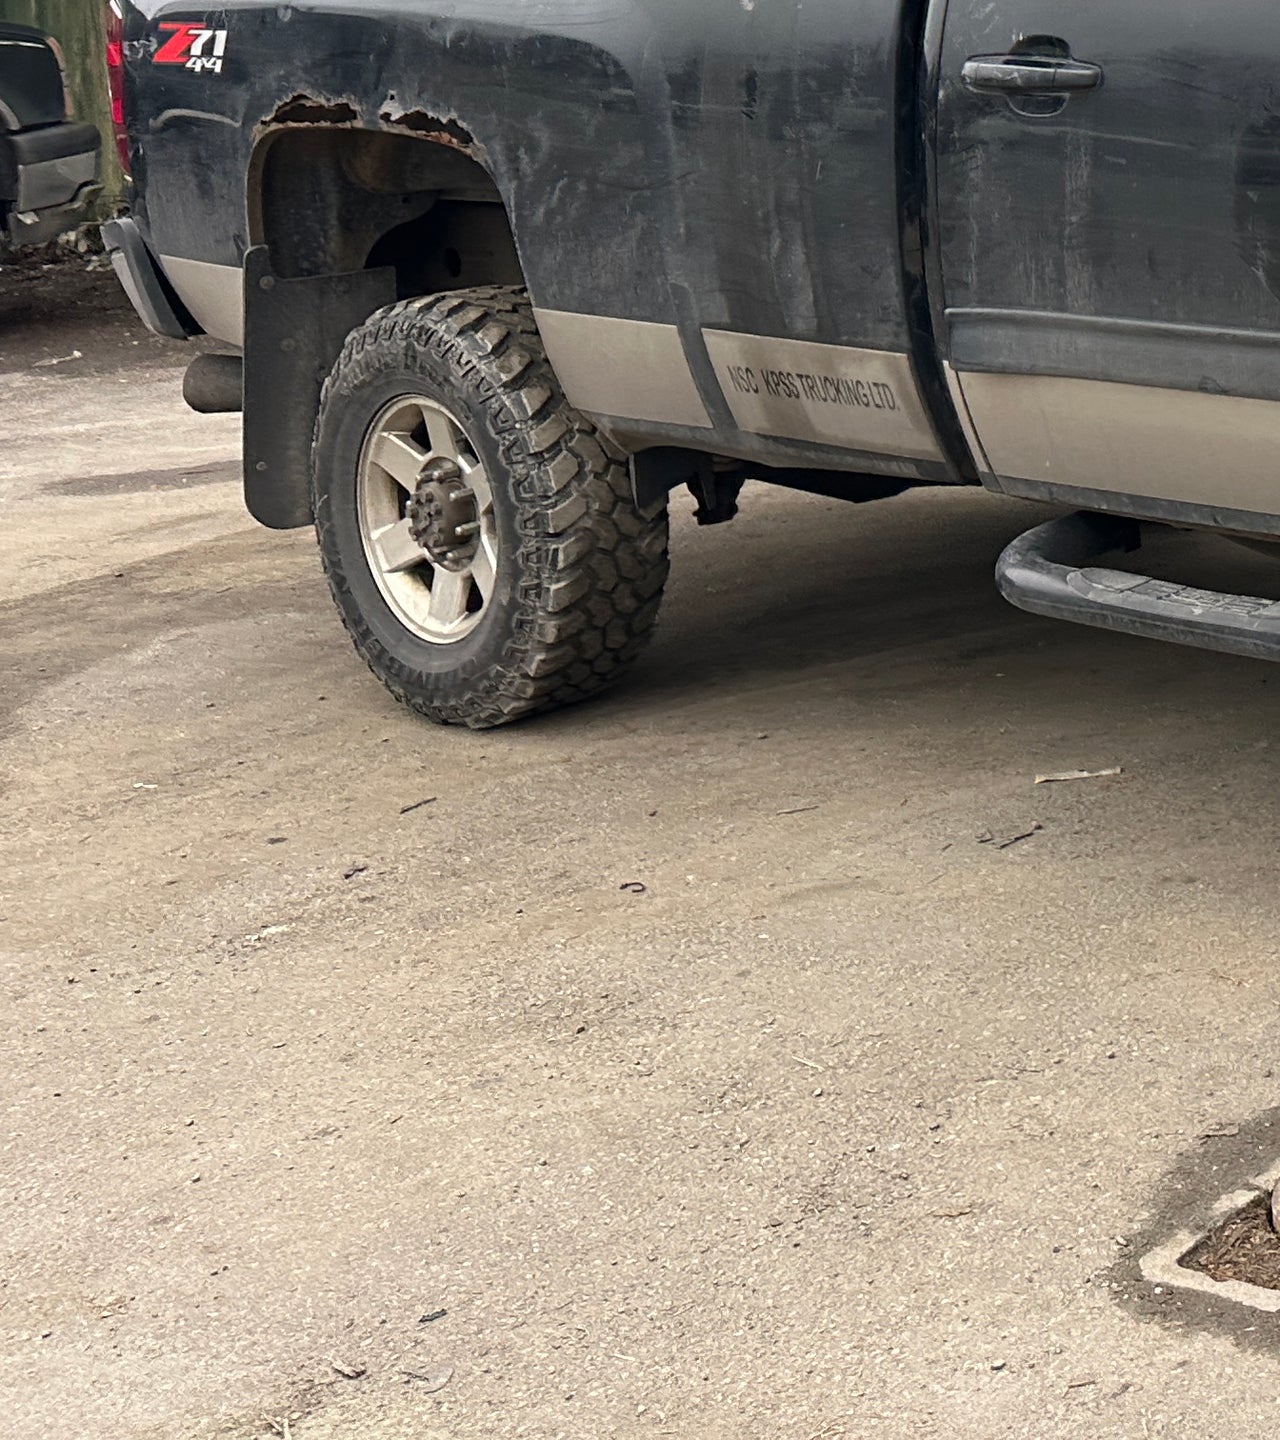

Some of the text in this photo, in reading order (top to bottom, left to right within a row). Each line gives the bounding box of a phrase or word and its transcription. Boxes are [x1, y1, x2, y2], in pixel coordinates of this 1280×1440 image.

[152, 22, 228, 64] Z71
[761, 369, 800, 399] KPSS
[795, 373, 870, 408] TRUCKING
